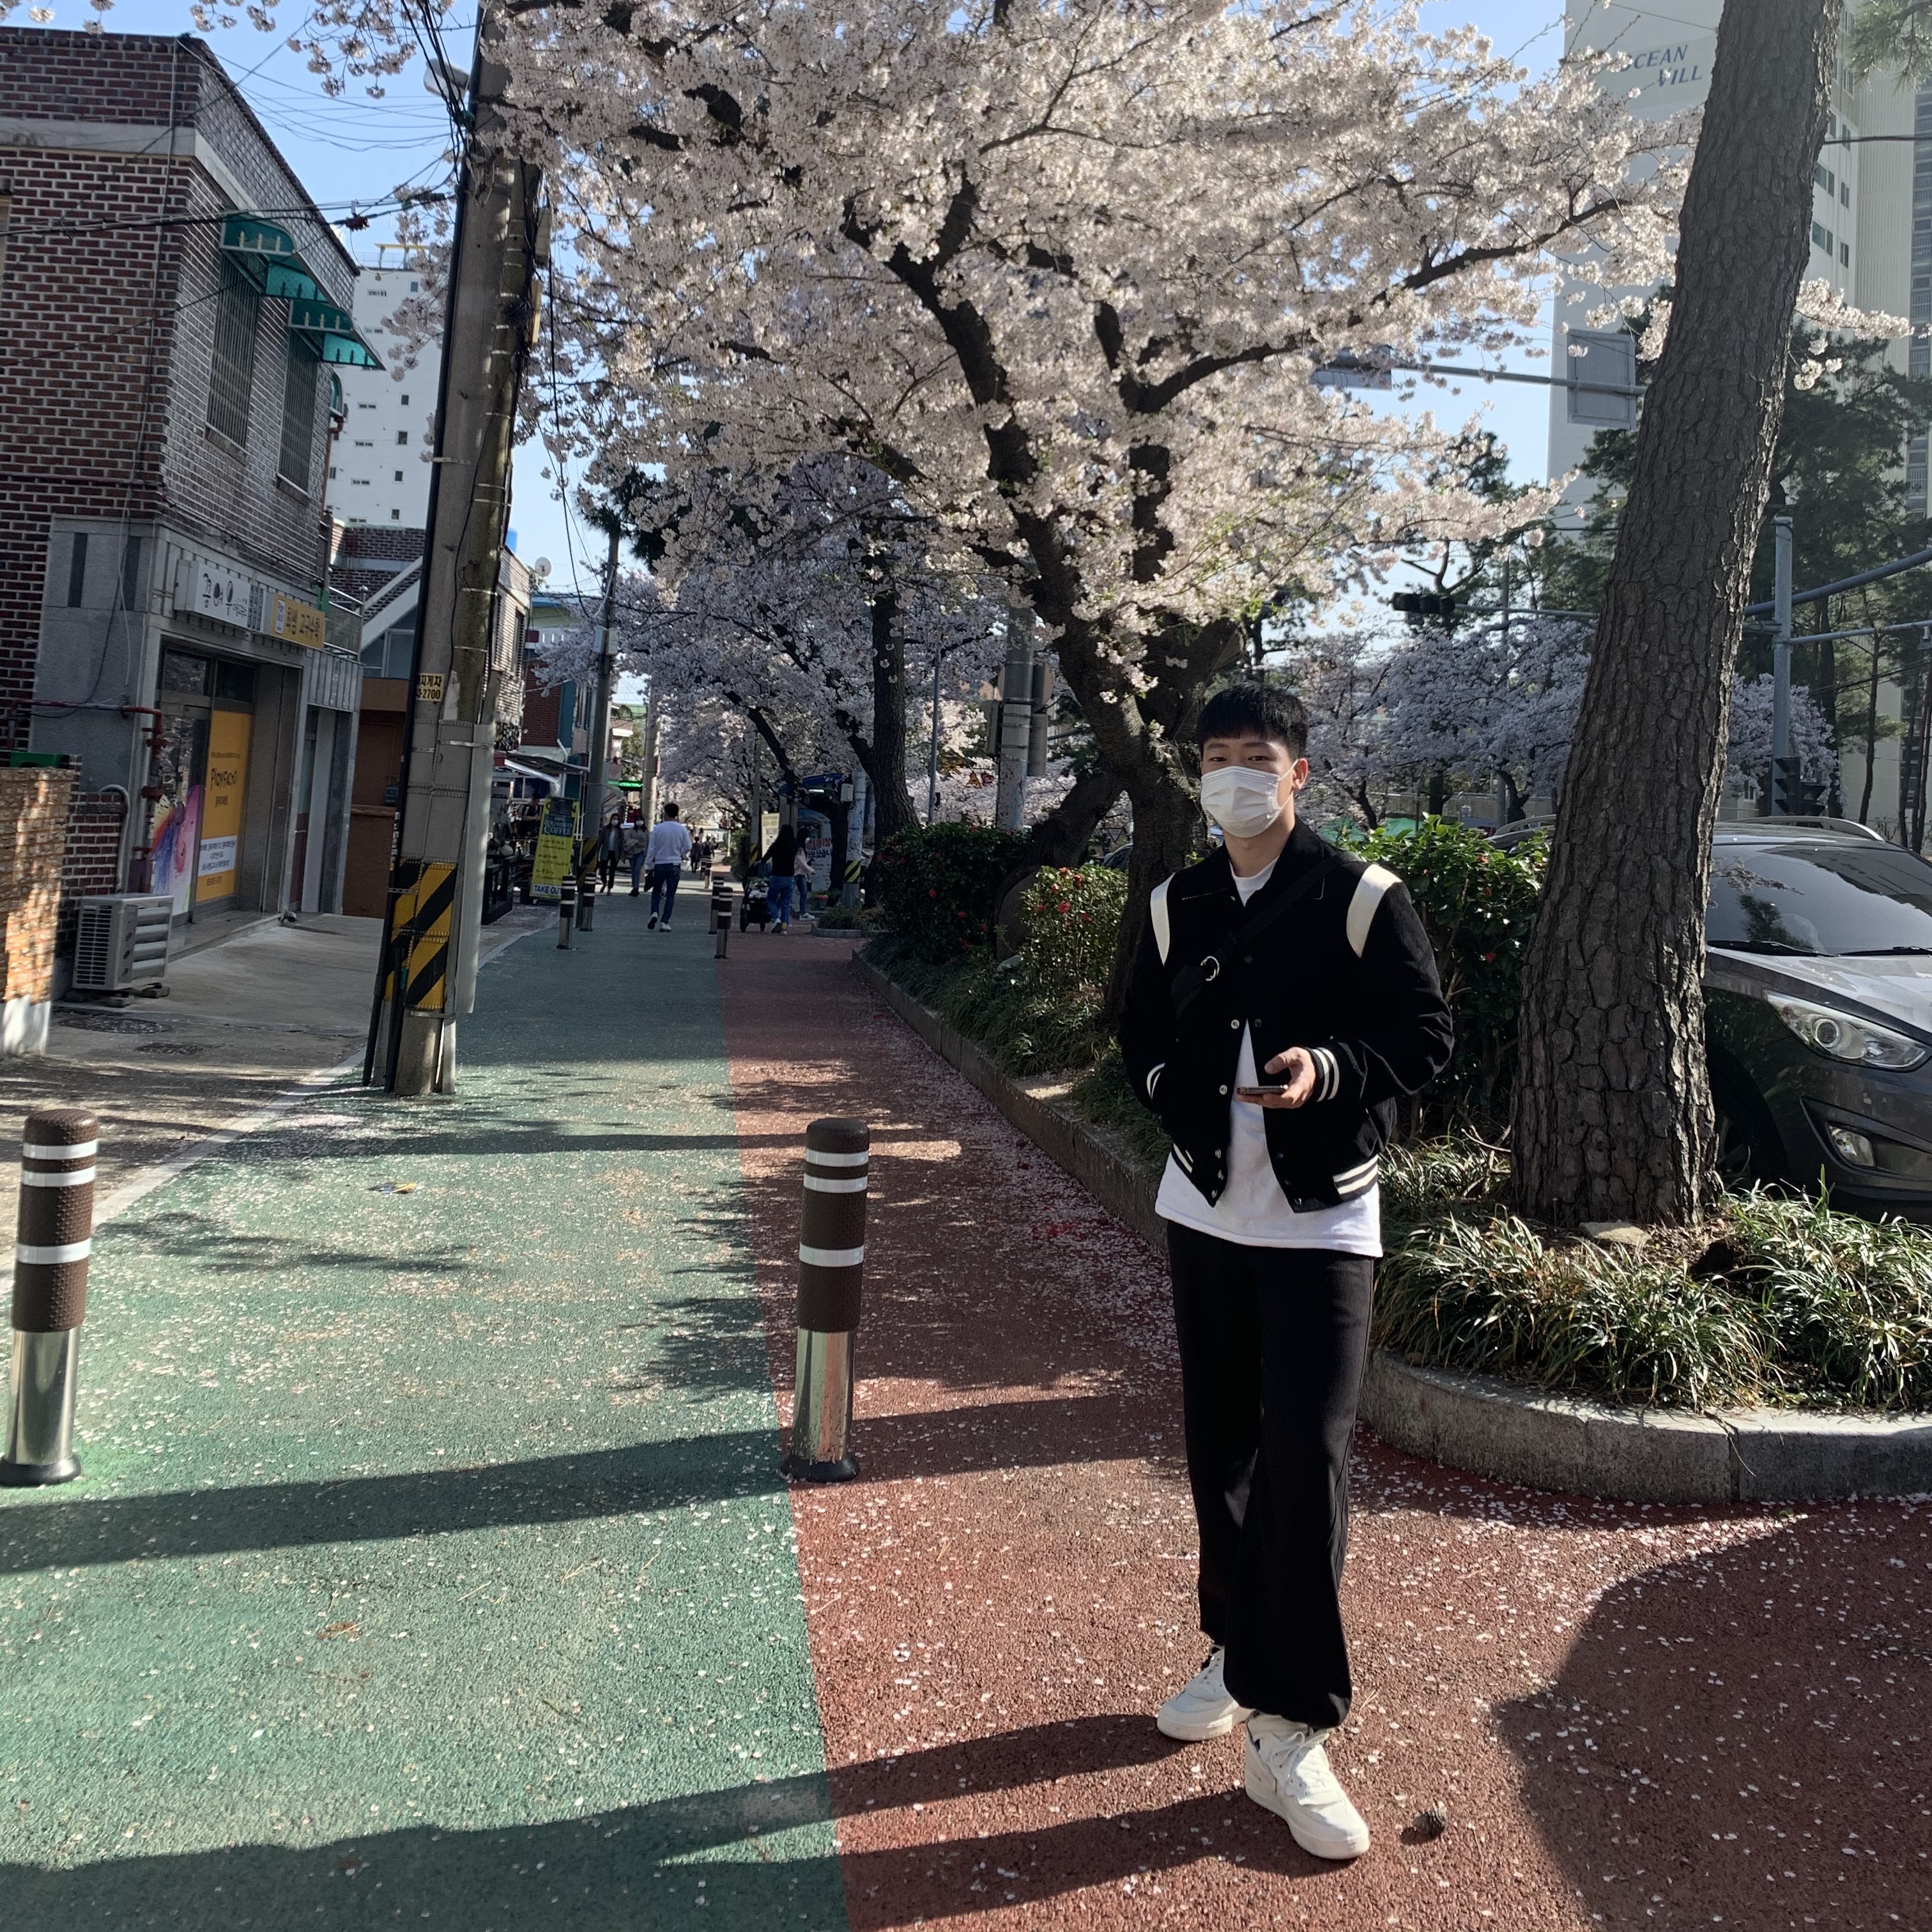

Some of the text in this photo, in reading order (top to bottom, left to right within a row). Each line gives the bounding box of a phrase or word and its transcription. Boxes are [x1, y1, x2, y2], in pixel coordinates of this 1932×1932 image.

[1658, 65, 1702, 87] VILL
[418, 675, 442, 687] 지게차
[533, 885, 549, 894] TAKE
